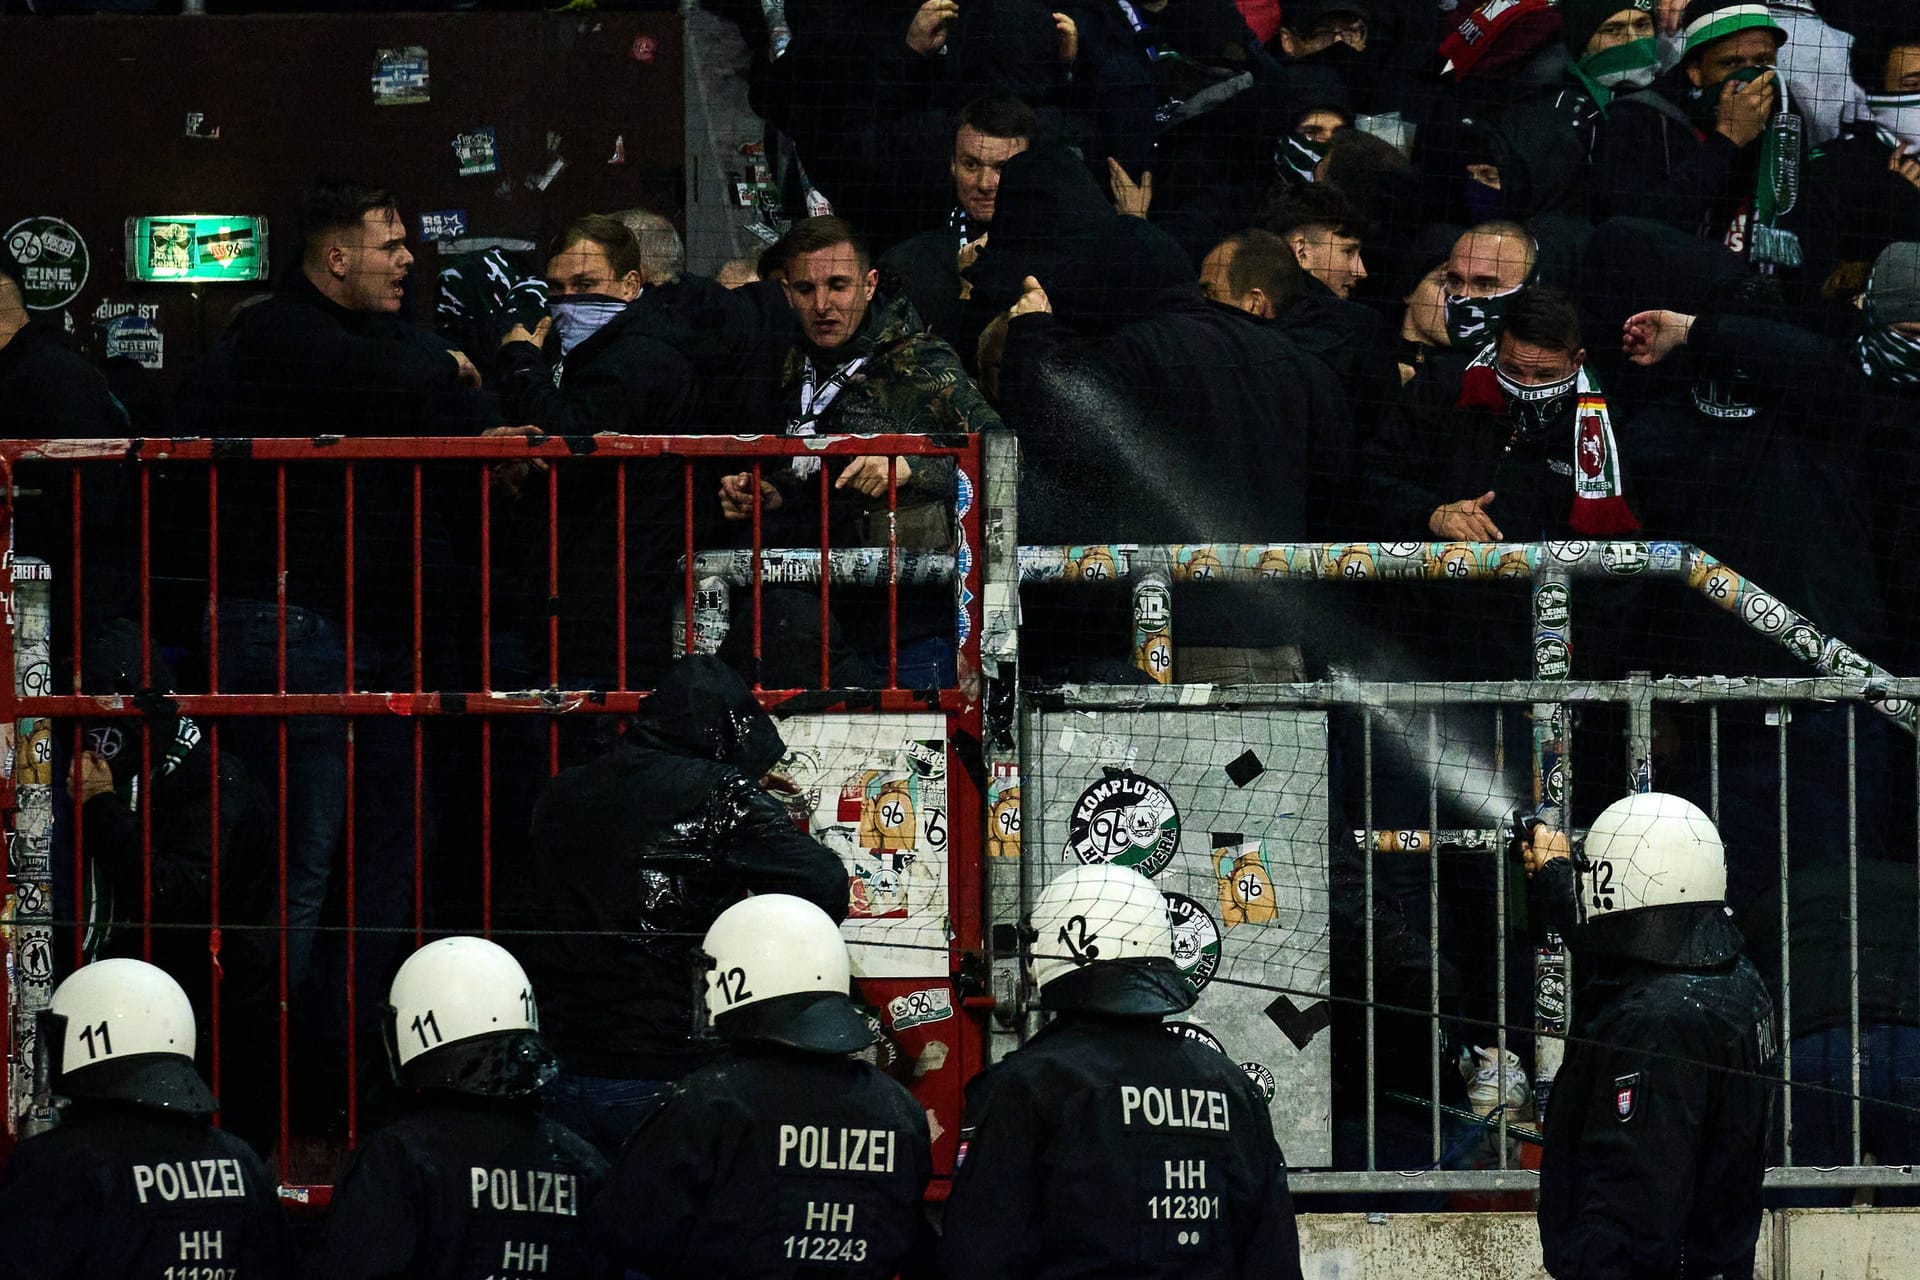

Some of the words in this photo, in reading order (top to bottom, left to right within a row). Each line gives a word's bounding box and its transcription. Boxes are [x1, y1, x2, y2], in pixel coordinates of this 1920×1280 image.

[226, 243, 241, 256] 96
[24, 268, 72, 280] EINE
[25, 282, 77, 290] LLEKTIV
[13, 565, 37, 580] EREIT
[1086, 563, 1106, 581] 96
[1345, 560, 1366, 579] 96
[1447, 557, 1469, 578] 96
[1708, 577, 1729, 599] 96
[1749, 597, 1781, 629] 96
[1151, 645, 1170, 672] 96
[35, 738, 51, 763] 96
[1076, 776, 1168, 822] KOMPLOTT
[882, 802, 903, 828] 96
[925, 808, 947, 847] 6
[1000, 808, 1020, 835] 96
[1094, 809, 1129, 856] 96
[1400, 831, 1421, 850] 96
[1238, 874, 1262, 903] 96
[1588, 860, 1615, 894] 12
[17, 883, 38, 911] 96
[1168, 898, 1212, 931] LOTT
[1058, 915, 1099, 960] 12
[716, 967, 753, 1005] 12
[910, 993, 930, 1016] 96
[79, 1021, 113, 1059] 11
[411, 1010, 443, 1049] 11
[1121, 1085, 1230, 1131] POLIZEI
[778, 1124, 895, 1172] POLIZEI
[133, 1159, 245, 1203] POLIZEI
[1165, 1160, 1206, 1189] HH
[471, 1167, 577, 1216] POLIZEI
[806, 1201, 854, 1232] HH
[1148, 1196, 1219, 1219] 112301
[179, 1230, 222, 1260] HH
[502, 1241, 548, 1272] HH
[784, 1235, 867, 1262] 112243
